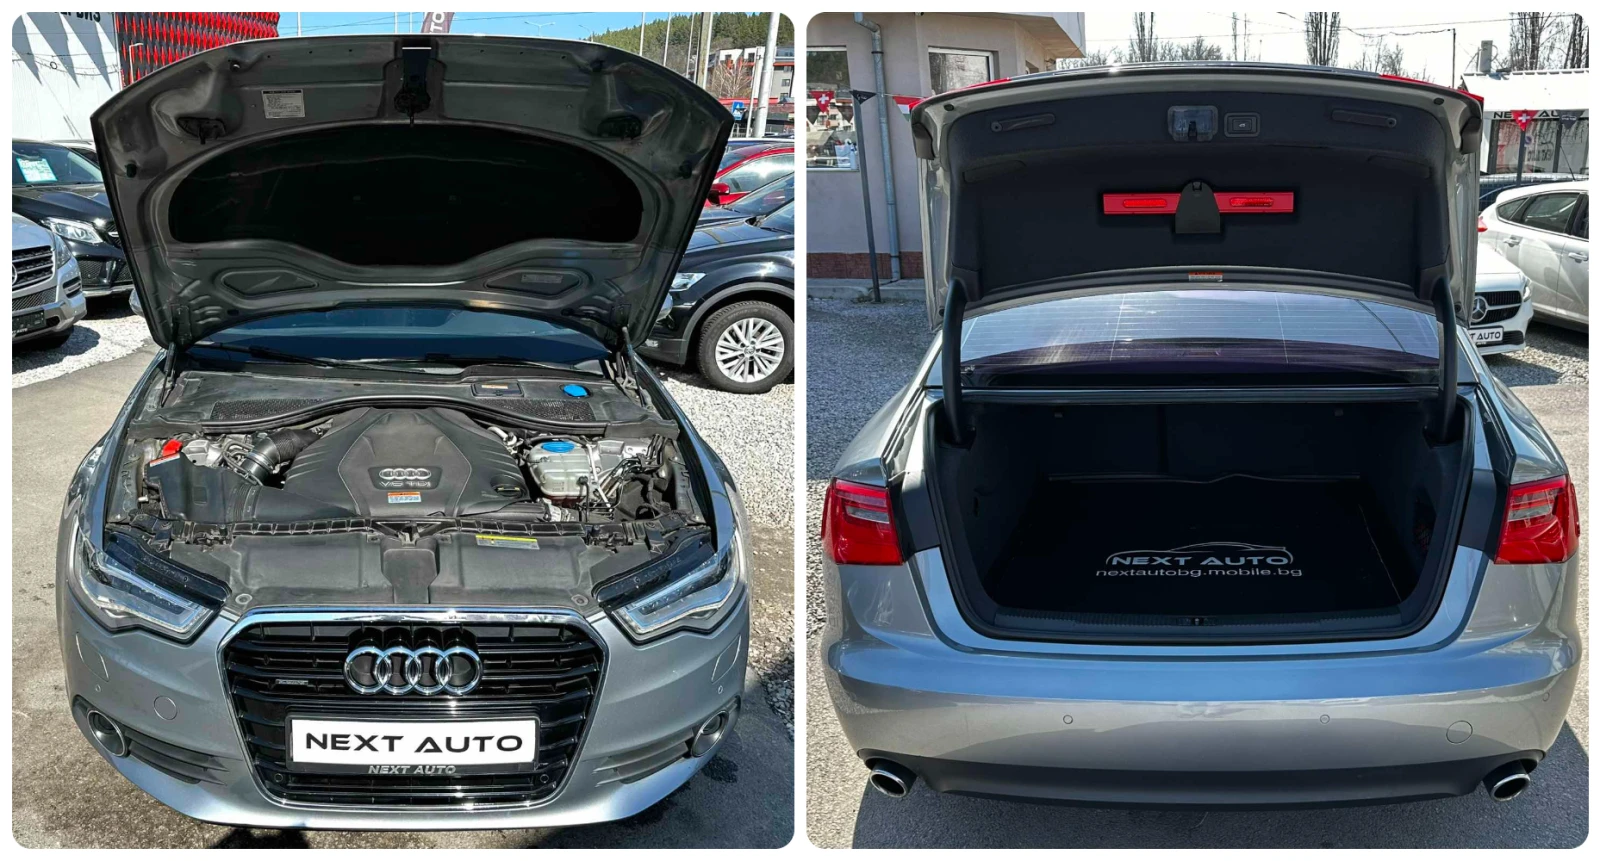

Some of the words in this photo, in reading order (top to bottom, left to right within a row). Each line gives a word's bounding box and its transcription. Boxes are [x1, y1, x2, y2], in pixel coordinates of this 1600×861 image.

[430, 12, 445, 33] TO
[1477, 331, 1501, 340] AUTO
[1111, 556, 1193, 566] NEXT
[1199, 556, 1289, 566] AUTO
[1096, 568, 1303, 578] nextautobg.mobile.bg
[305, 732, 404, 752] NEXT
[414, 735, 523, 753] AUTO
[368, 765, 411, 775] NEXT
[413, 765, 456, 775] AUTO
